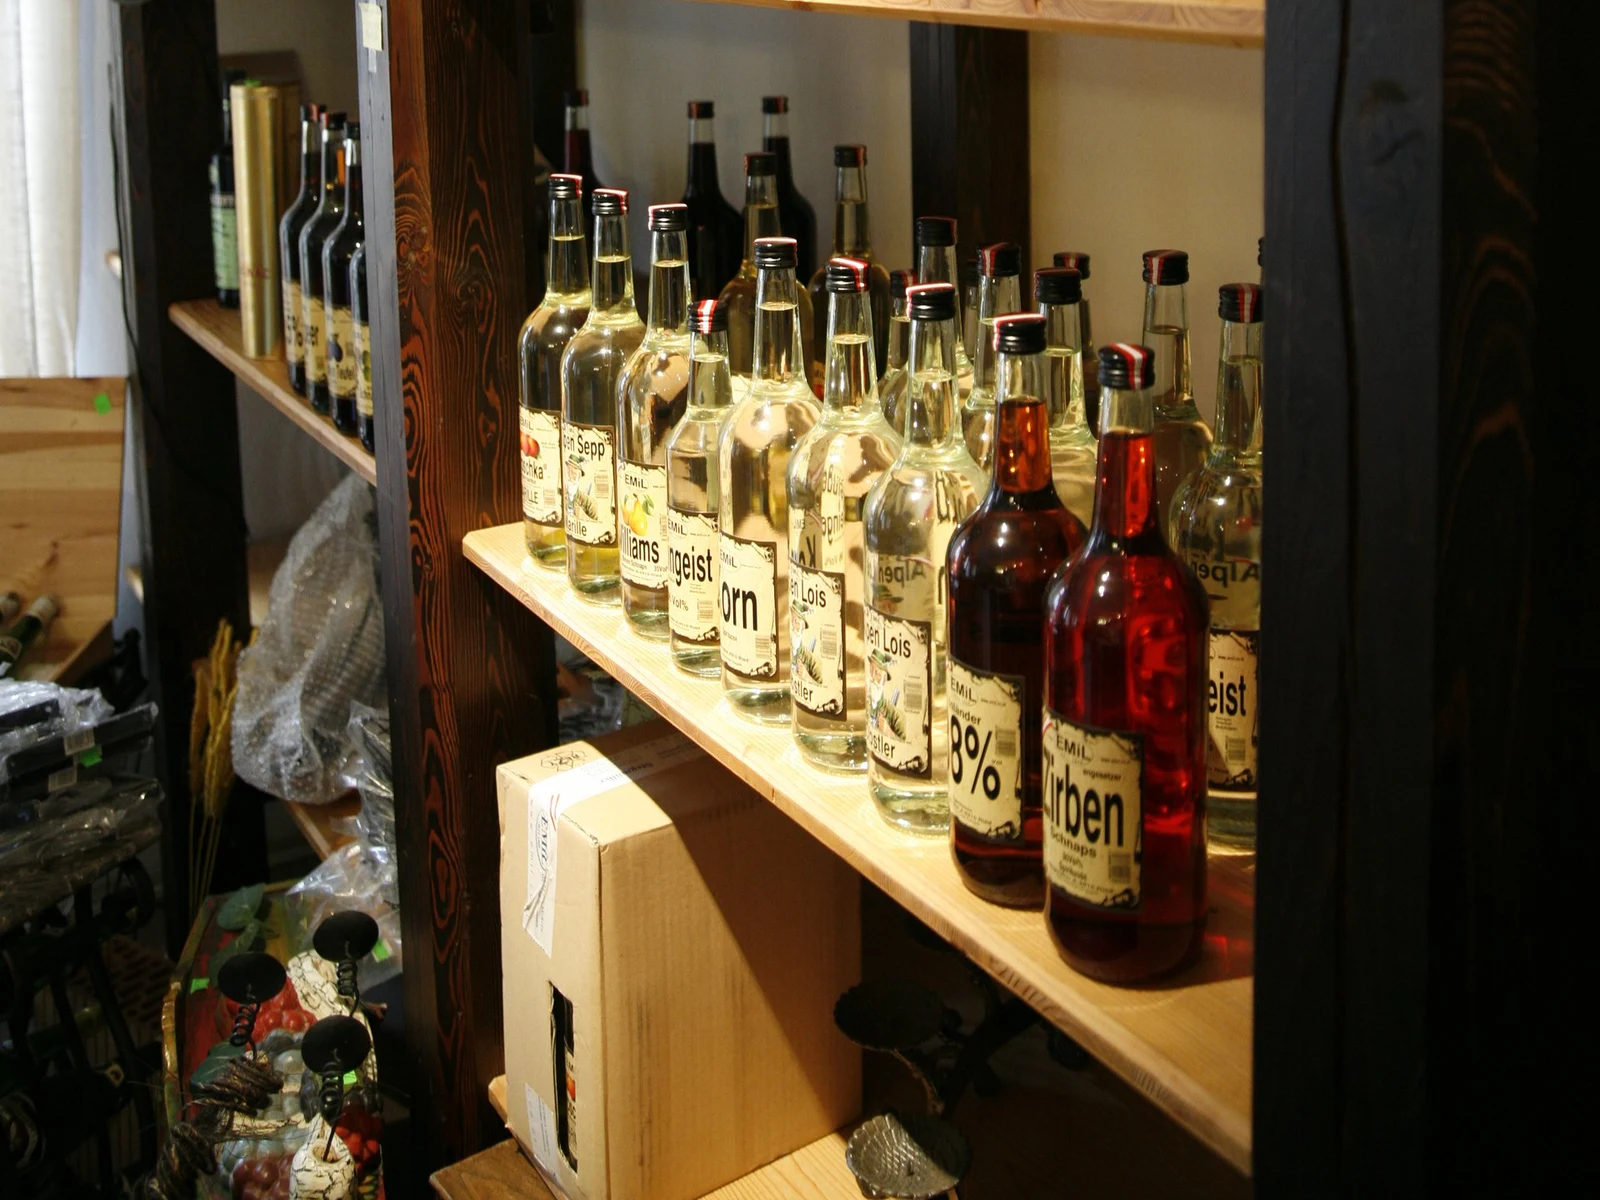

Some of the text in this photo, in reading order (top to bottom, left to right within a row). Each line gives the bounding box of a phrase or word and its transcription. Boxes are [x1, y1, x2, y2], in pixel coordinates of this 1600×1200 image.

[578, 434, 605, 461] Sepp
[624, 473, 648, 490] EMiL
[802, 583, 827, 609] Lois
[883, 626, 911, 658] Lois
[950, 676, 977, 703] EMiL
[1056, 734, 1092, 763] EMiL
